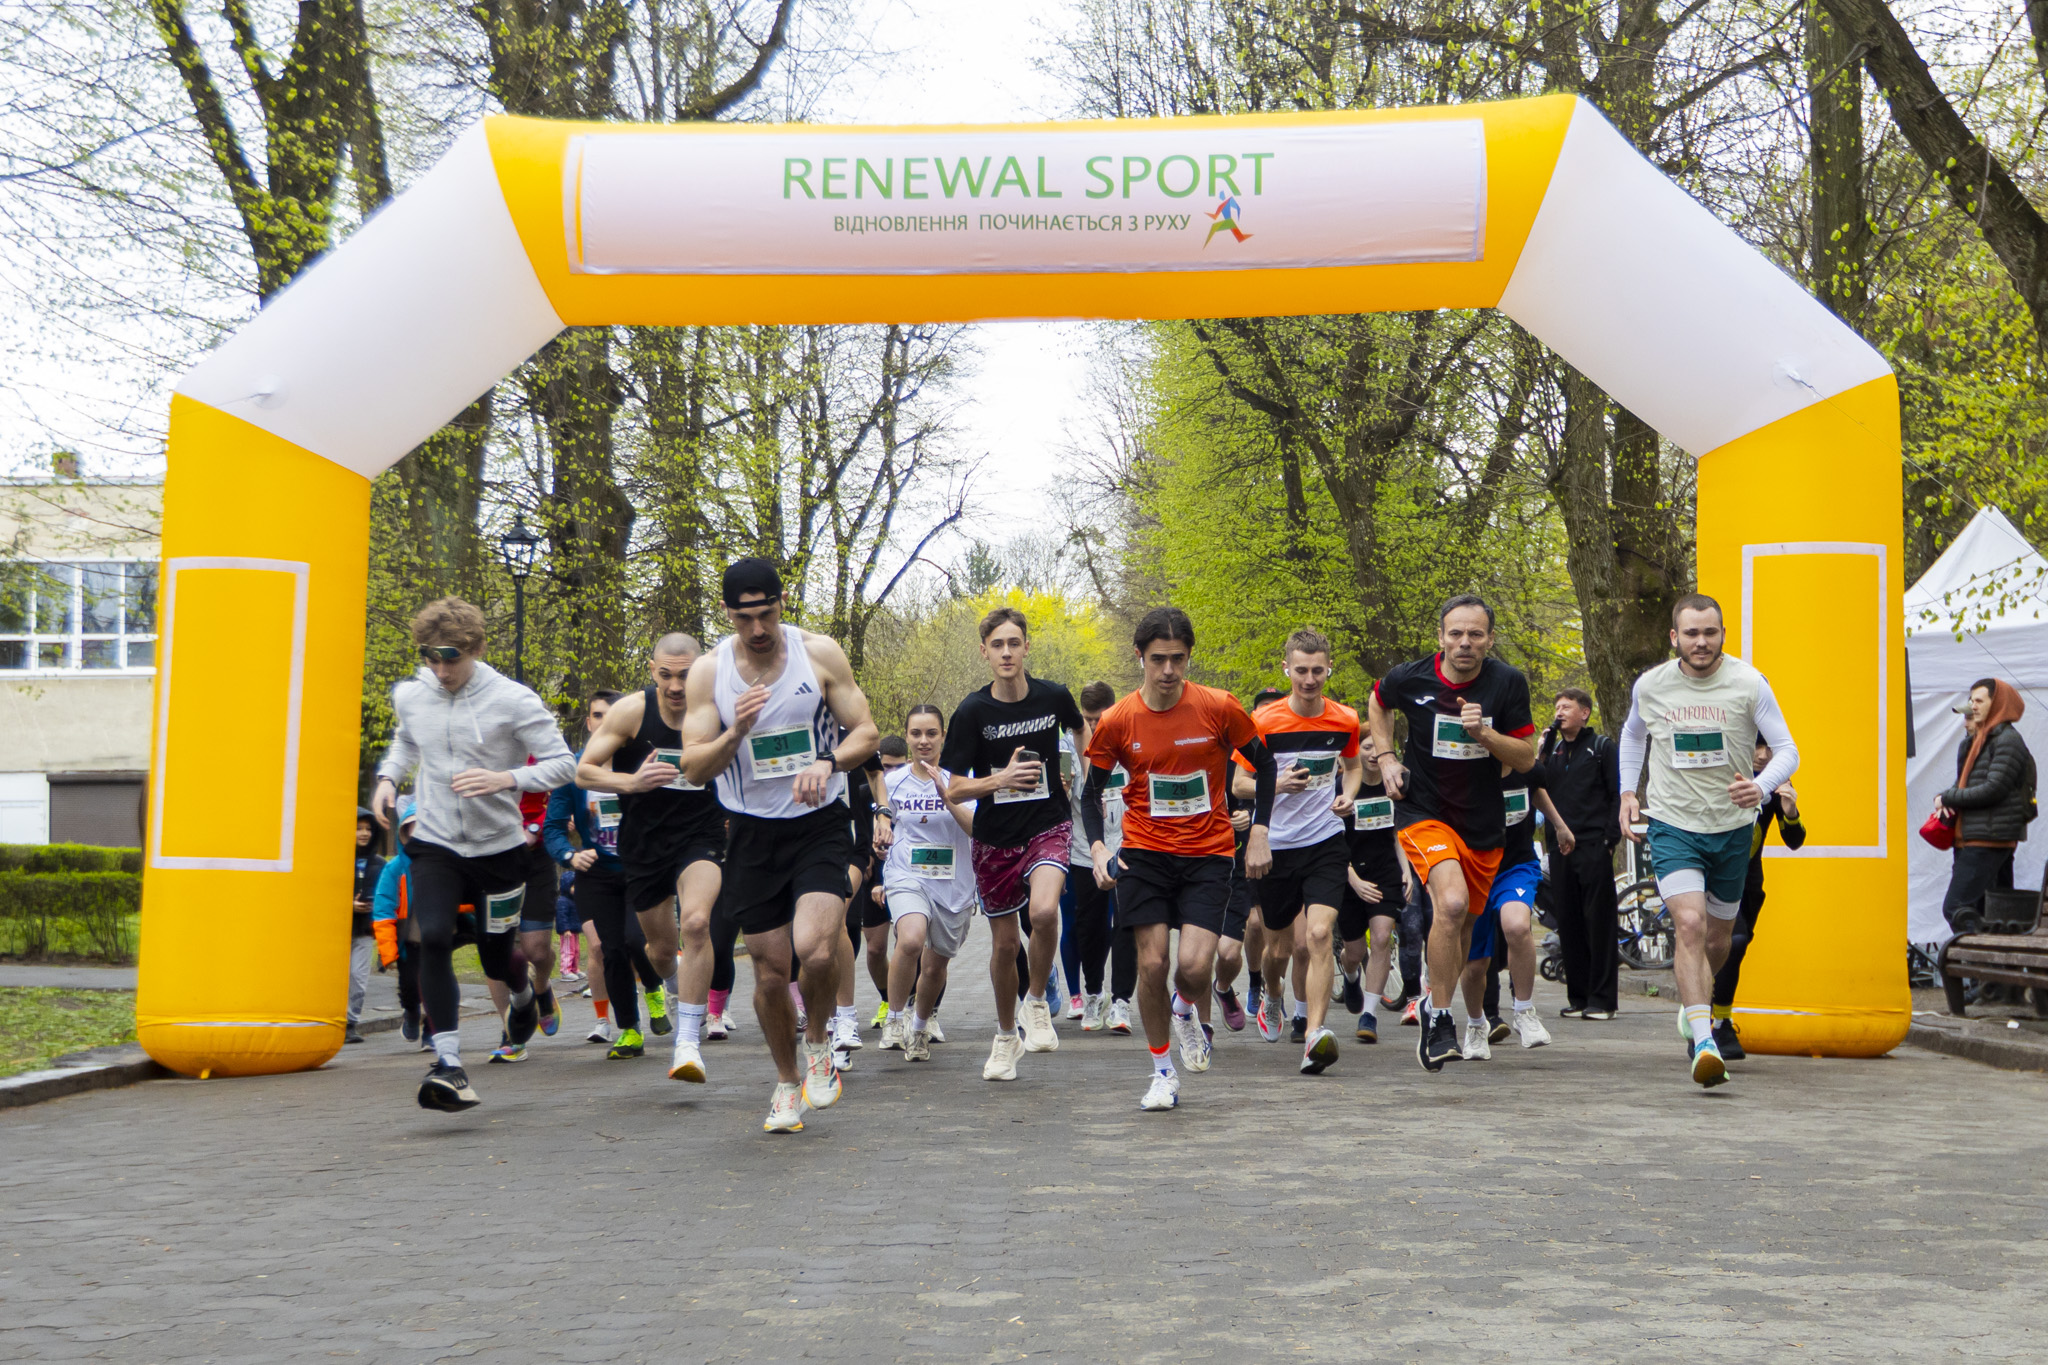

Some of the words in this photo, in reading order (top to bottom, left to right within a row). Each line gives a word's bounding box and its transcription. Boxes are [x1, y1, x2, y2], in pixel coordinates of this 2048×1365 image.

[783, 156, 1062, 200] RENEWAL
[1085, 152, 1275, 199] SPORT
[833, 214, 968, 234] ВІДНОВЛЕННЯ
[979, 213, 1122, 232] ПОЧИНАЄТЬСЯ
[1128, 214, 1138, 231] З
[1144, 213, 1191, 231] РУХУ
[1664, 705, 1727, 724] CALIFORNIA
[996, 714, 1056, 739] RUNNING
[773, 735, 789, 752] 31
[1695, 735, 1700, 747] 1
[1172, 783, 1187, 796] 29
[1371, 803, 1380, 814] 15
[925, 850, 938, 861] 24
